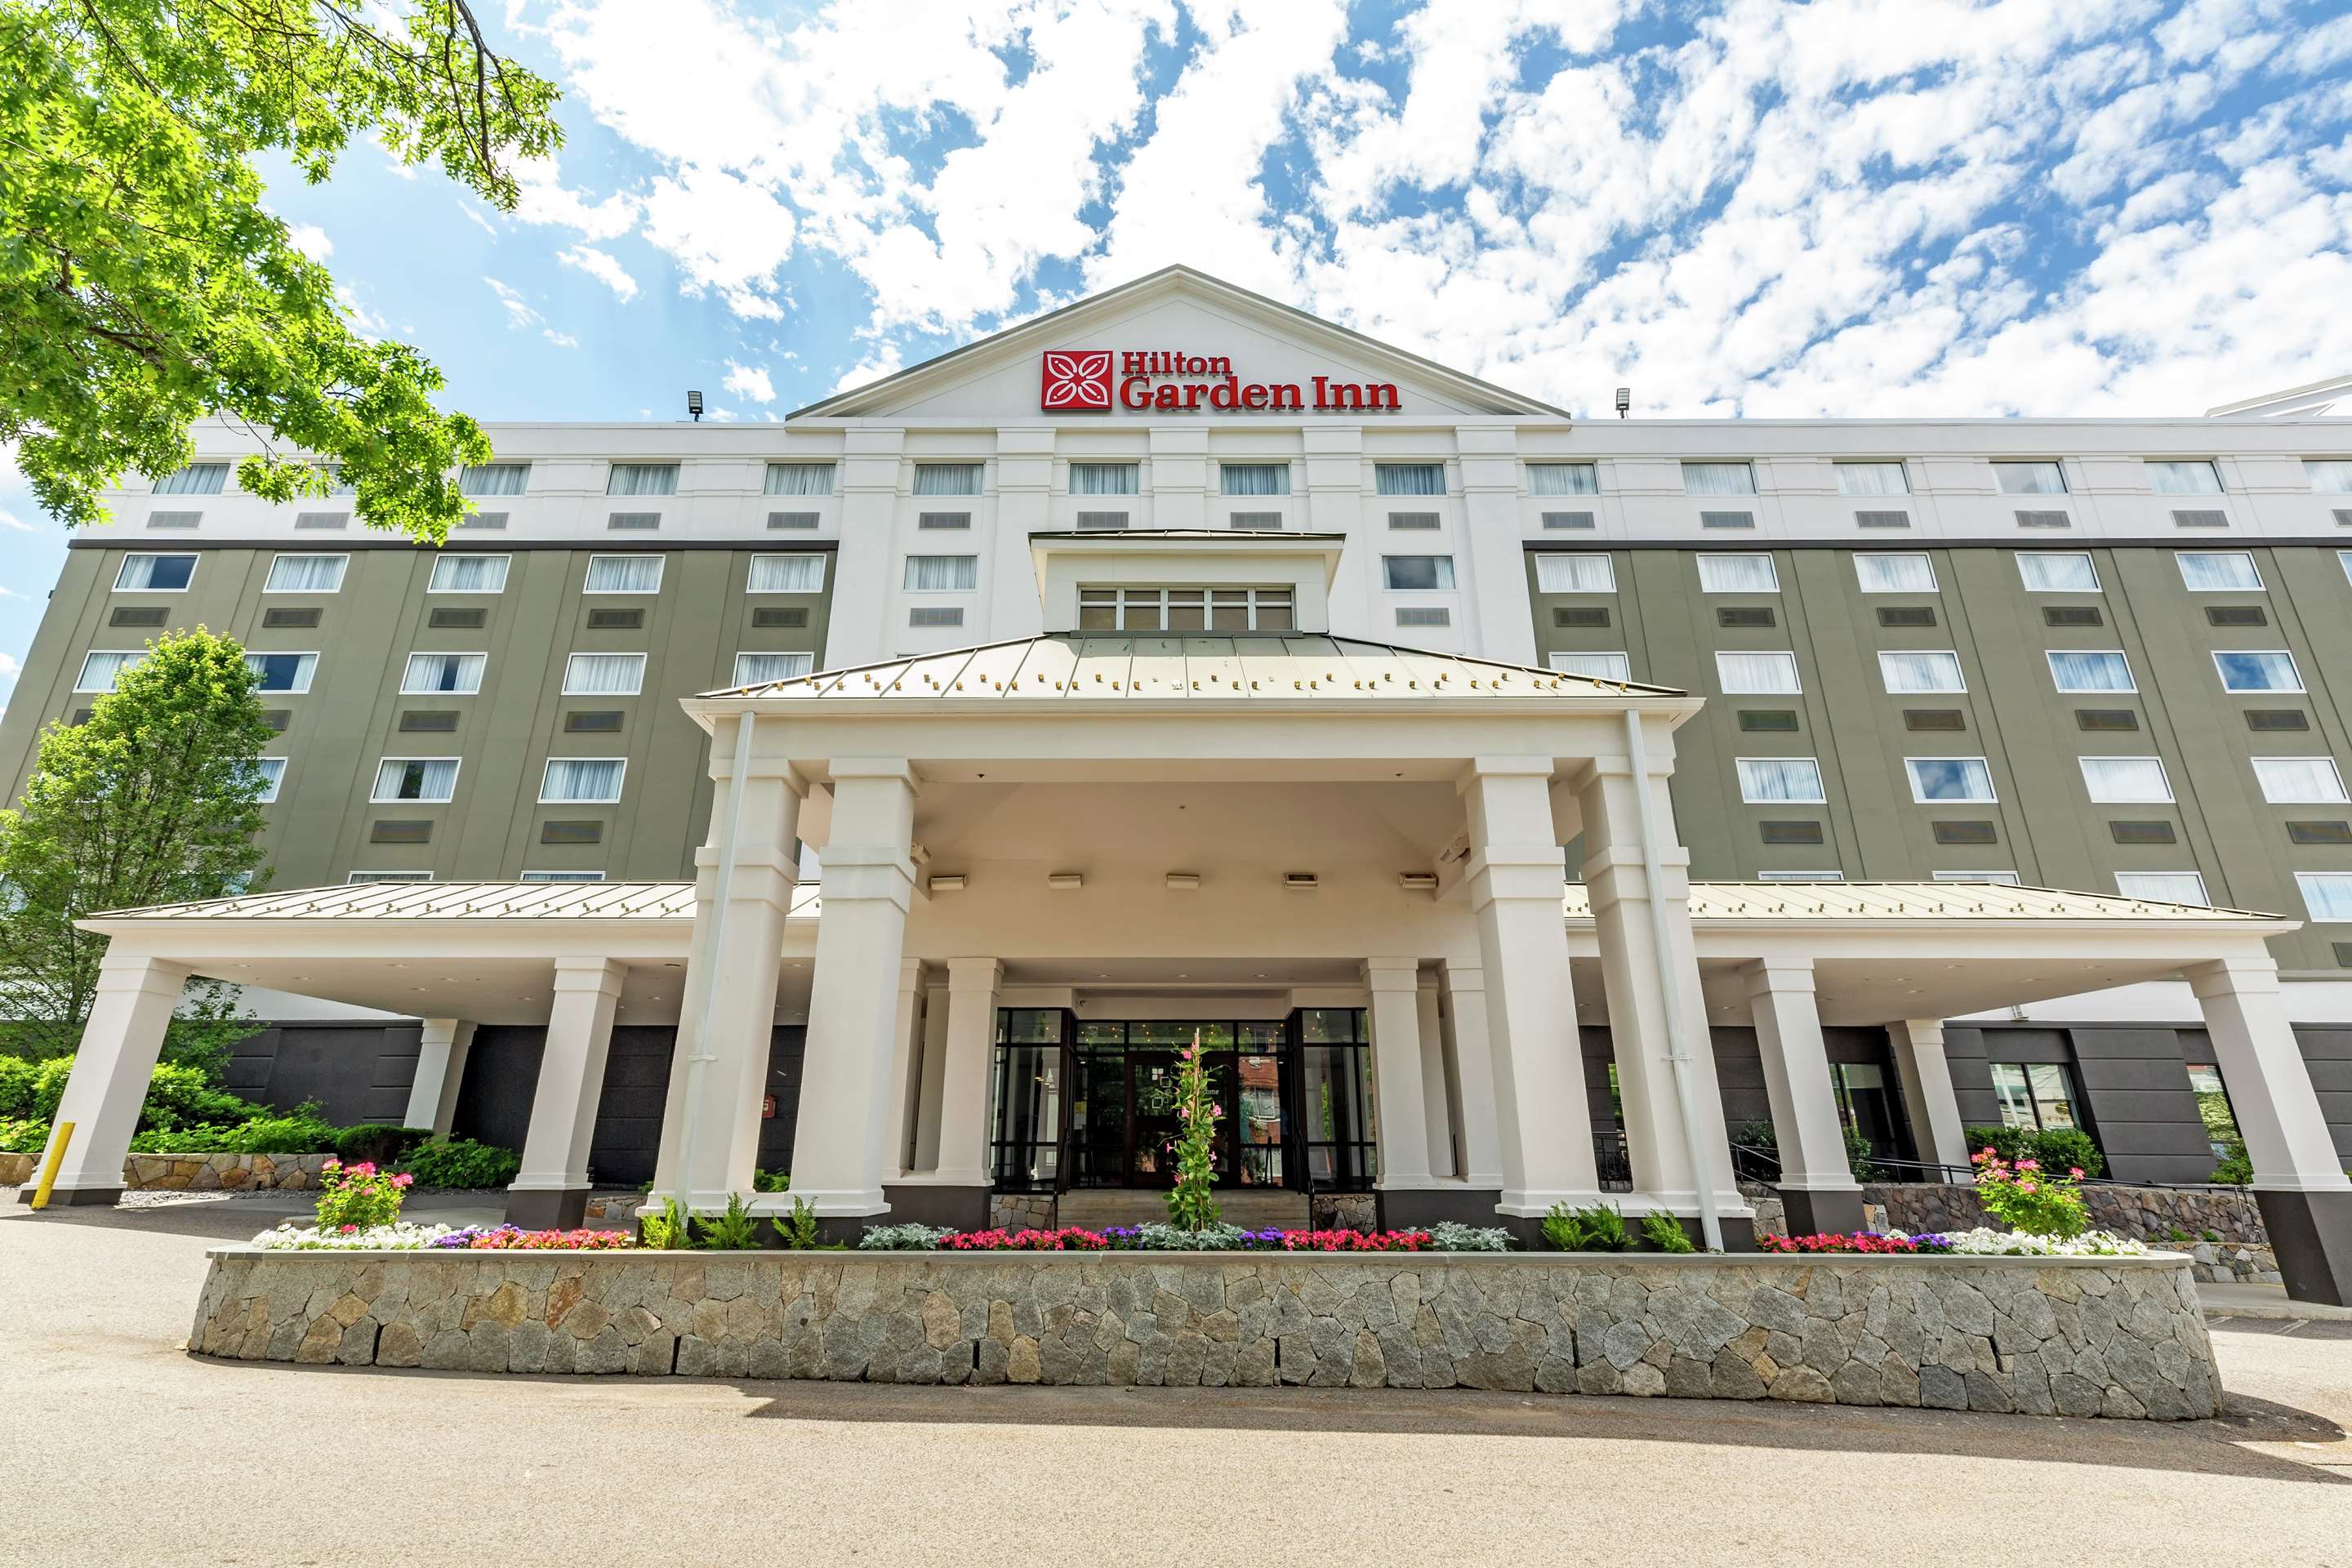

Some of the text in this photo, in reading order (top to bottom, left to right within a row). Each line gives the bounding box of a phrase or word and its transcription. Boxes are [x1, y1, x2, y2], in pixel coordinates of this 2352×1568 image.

[1121, 351, 1233, 376] Hilton
[1120, 376, 1402, 411] Garden Inn
